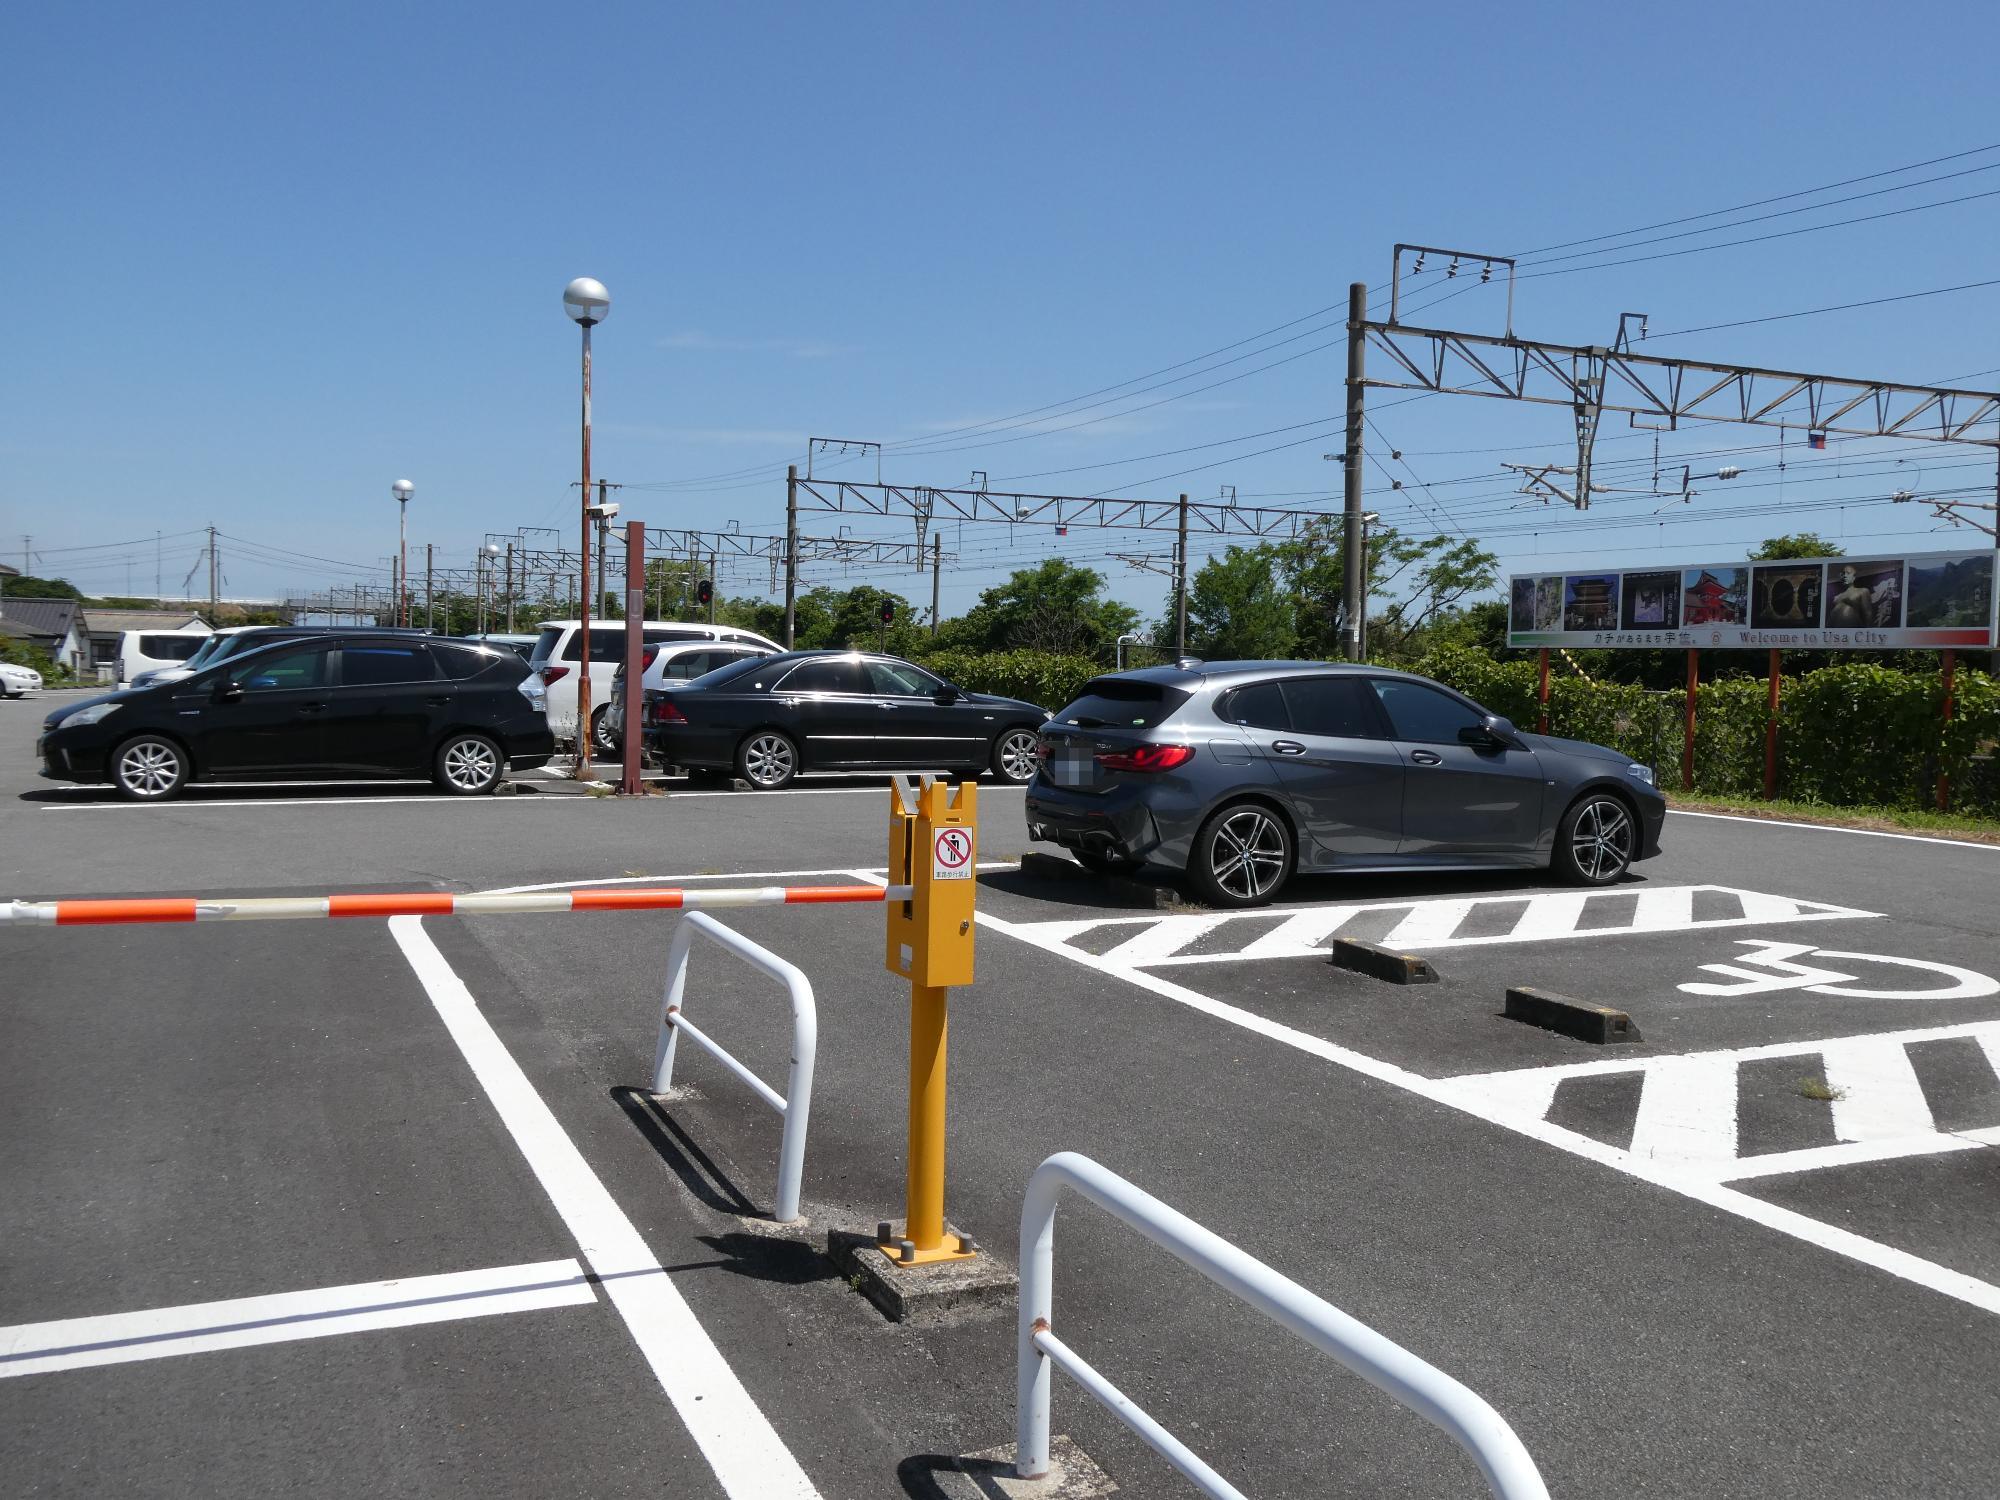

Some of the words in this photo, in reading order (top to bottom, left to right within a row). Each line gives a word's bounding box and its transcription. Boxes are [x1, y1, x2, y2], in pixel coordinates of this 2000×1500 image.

[1739, 631, 1799, 644] Welcome
[1803, 632, 1818, 644] to
[1822, 631, 1849, 644] Usa
[1854, 631, 1888, 645] City
